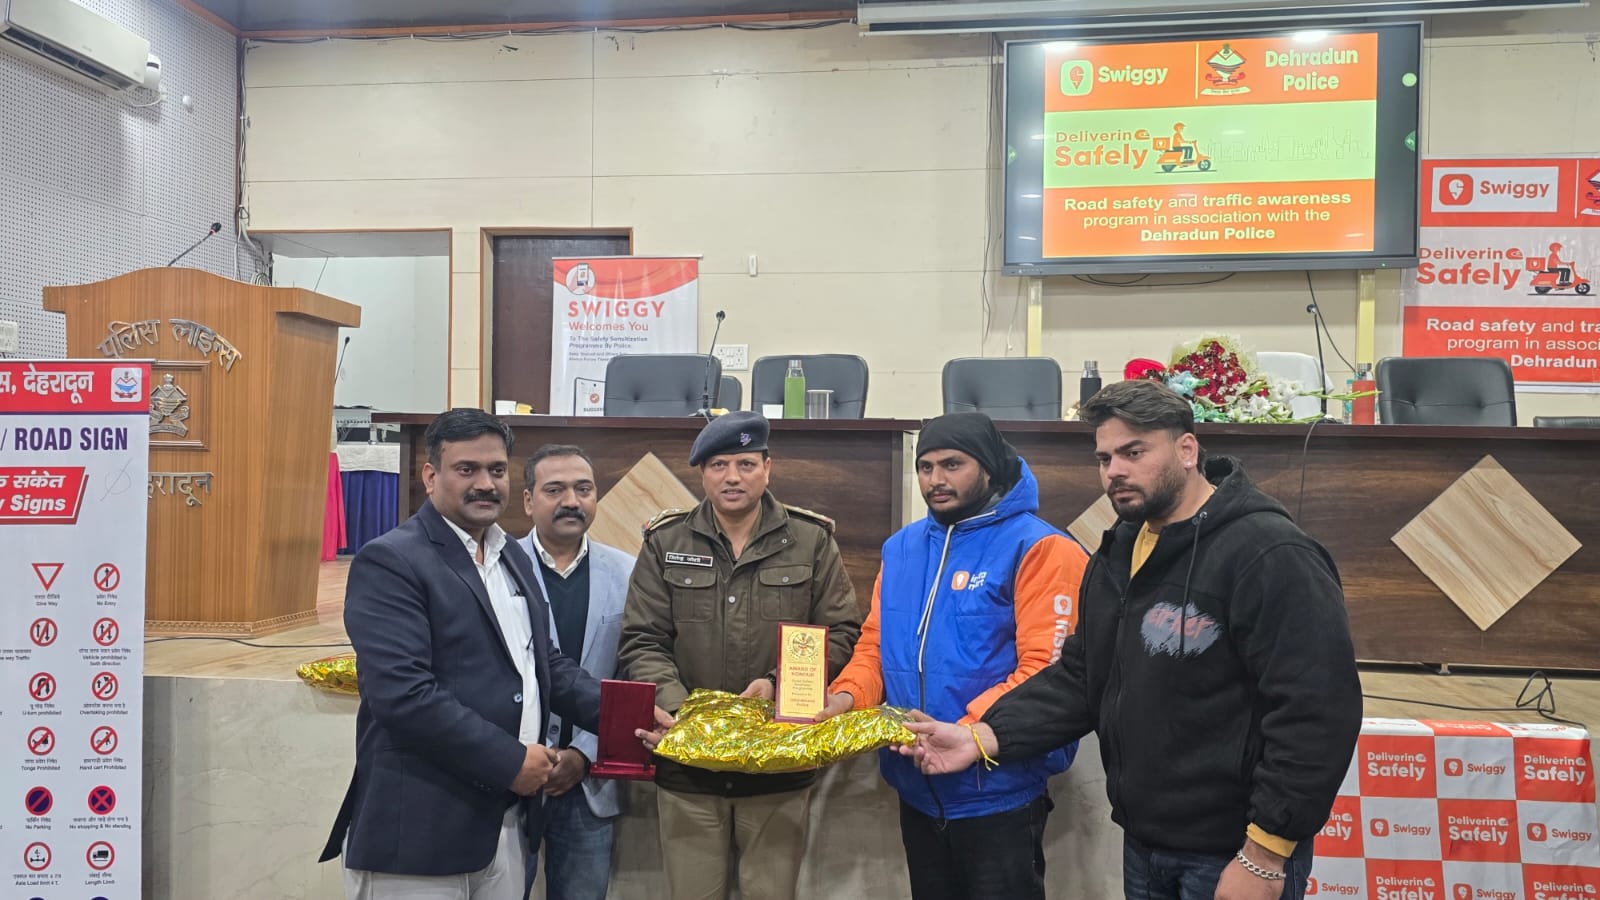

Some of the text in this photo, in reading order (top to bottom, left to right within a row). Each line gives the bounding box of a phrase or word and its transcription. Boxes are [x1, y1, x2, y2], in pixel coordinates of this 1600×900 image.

[1265, 48, 1359, 68] Dehradun
[1098, 65, 1168, 85] Swiggy
[1283, 72, 1340, 91] Police
[1054, 144, 1148, 169] Safely
[1480, 180, 1549, 198] Swiggy
[1064, 192, 1351, 213] Road safety and traffic awareness
[1083, 208, 1330, 229] program in association with the
[1140, 227, 1275, 242] Dehradun Police
[1416, 262, 1521, 290] Safely
[568, 300, 665, 318] SWIGGY
[568, 321, 649, 331] Welcomes You
[1426, 318, 1474, 332] Road
[1480, 319, 1536, 335] safety
[1542, 320, 1574, 333] and
[1447, 338, 1519, 351] program
[1525, 336, 1540, 350] in
[1511, 355, 1597, 368] Dehradun
[23, 363, 94, 404] देहरादून
[15, 427, 72, 451] ROAD
[80, 427, 128, 451] SIGN
[13, 470, 66, 488] संकेत
[10, 494, 66, 514] Signs
[1367, 762, 1425, 781] Safely
[1467, 763, 1506, 775] Swiggy
[1524, 765, 1585, 785] Safely
[1393, 824, 1431, 835] Swiggy
[1449, 826, 1508, 845] Safely
[1552, 828, 1592, 841] Swiggy
[1322, 883, 1359, 895] Swiggy
[1376, 887, 1435, 900] Safely
[1476, 889, 1516, 900] Swiggy
